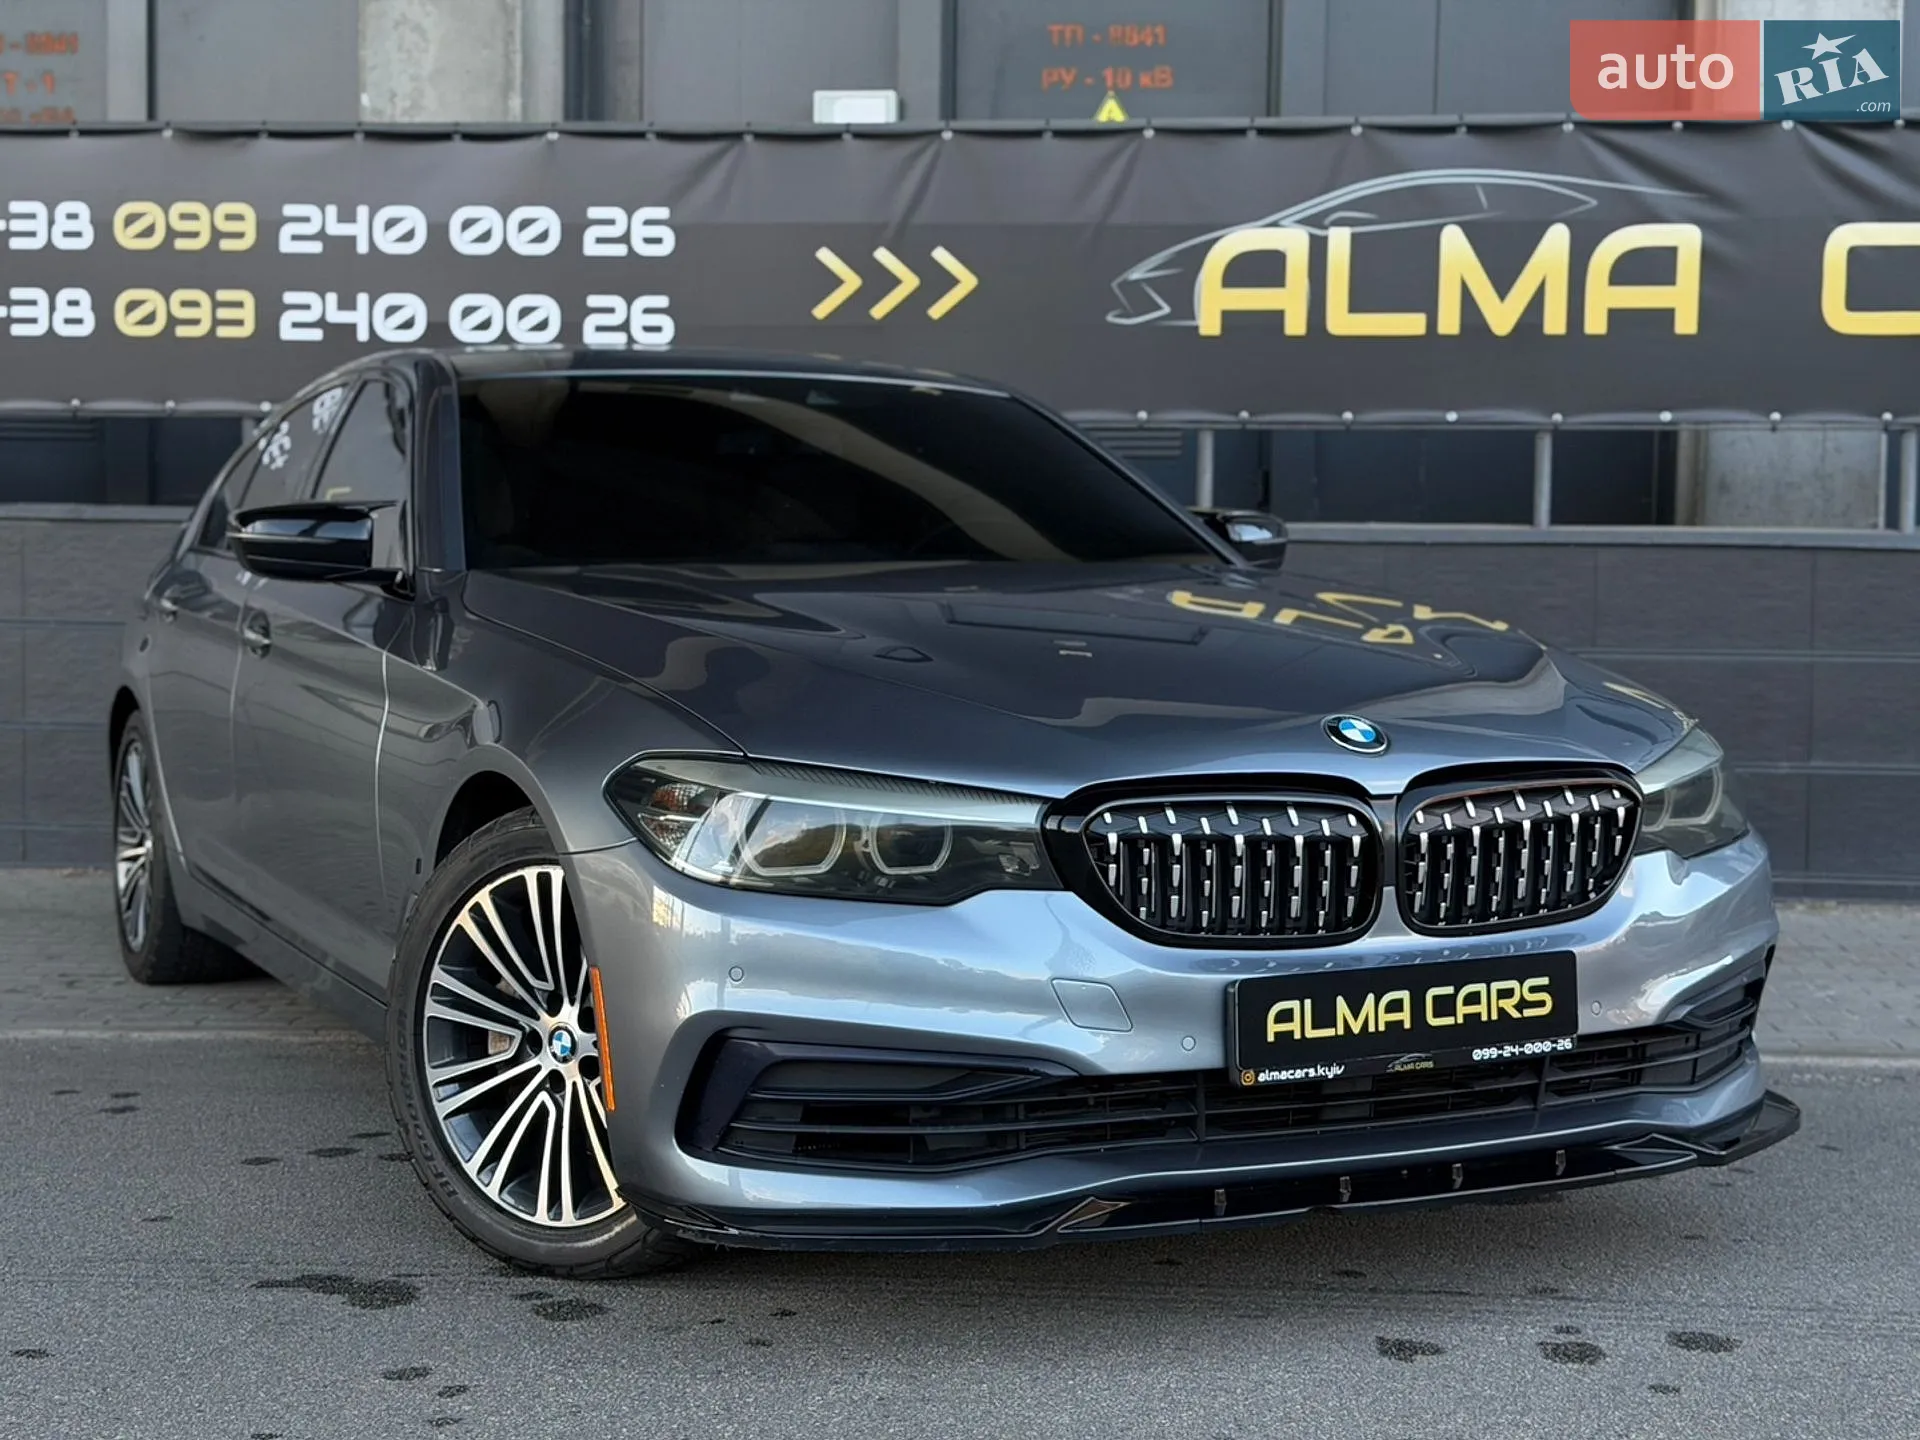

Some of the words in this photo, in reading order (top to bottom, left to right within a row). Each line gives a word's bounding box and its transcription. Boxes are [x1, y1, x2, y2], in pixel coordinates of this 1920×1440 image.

[1042, 66, 1077, 90] РУ
[1103, 67, 1134, 91] 10
[114, 202, 256, 250] 099
[279, 204, 427, 254] 240
[449, 205, 561, 255] 00
[583, 206, 675, 256] 26
[1198, 223, 1703, 337] ALMA
[115, 289, 255, 337] 093
[280, 291, 427, 341] 240
[449, 294, 561, 344] 00
[583, 295, 674, 346] 26
[1267, 989, 1411, 1042] ALMA
[1425, 976, 1554, 1027] CARS
[1258, 1063, 1345, 1083] almacars.kyiv
[1472, 1039, 1573, 1061] 099-24-000-26
